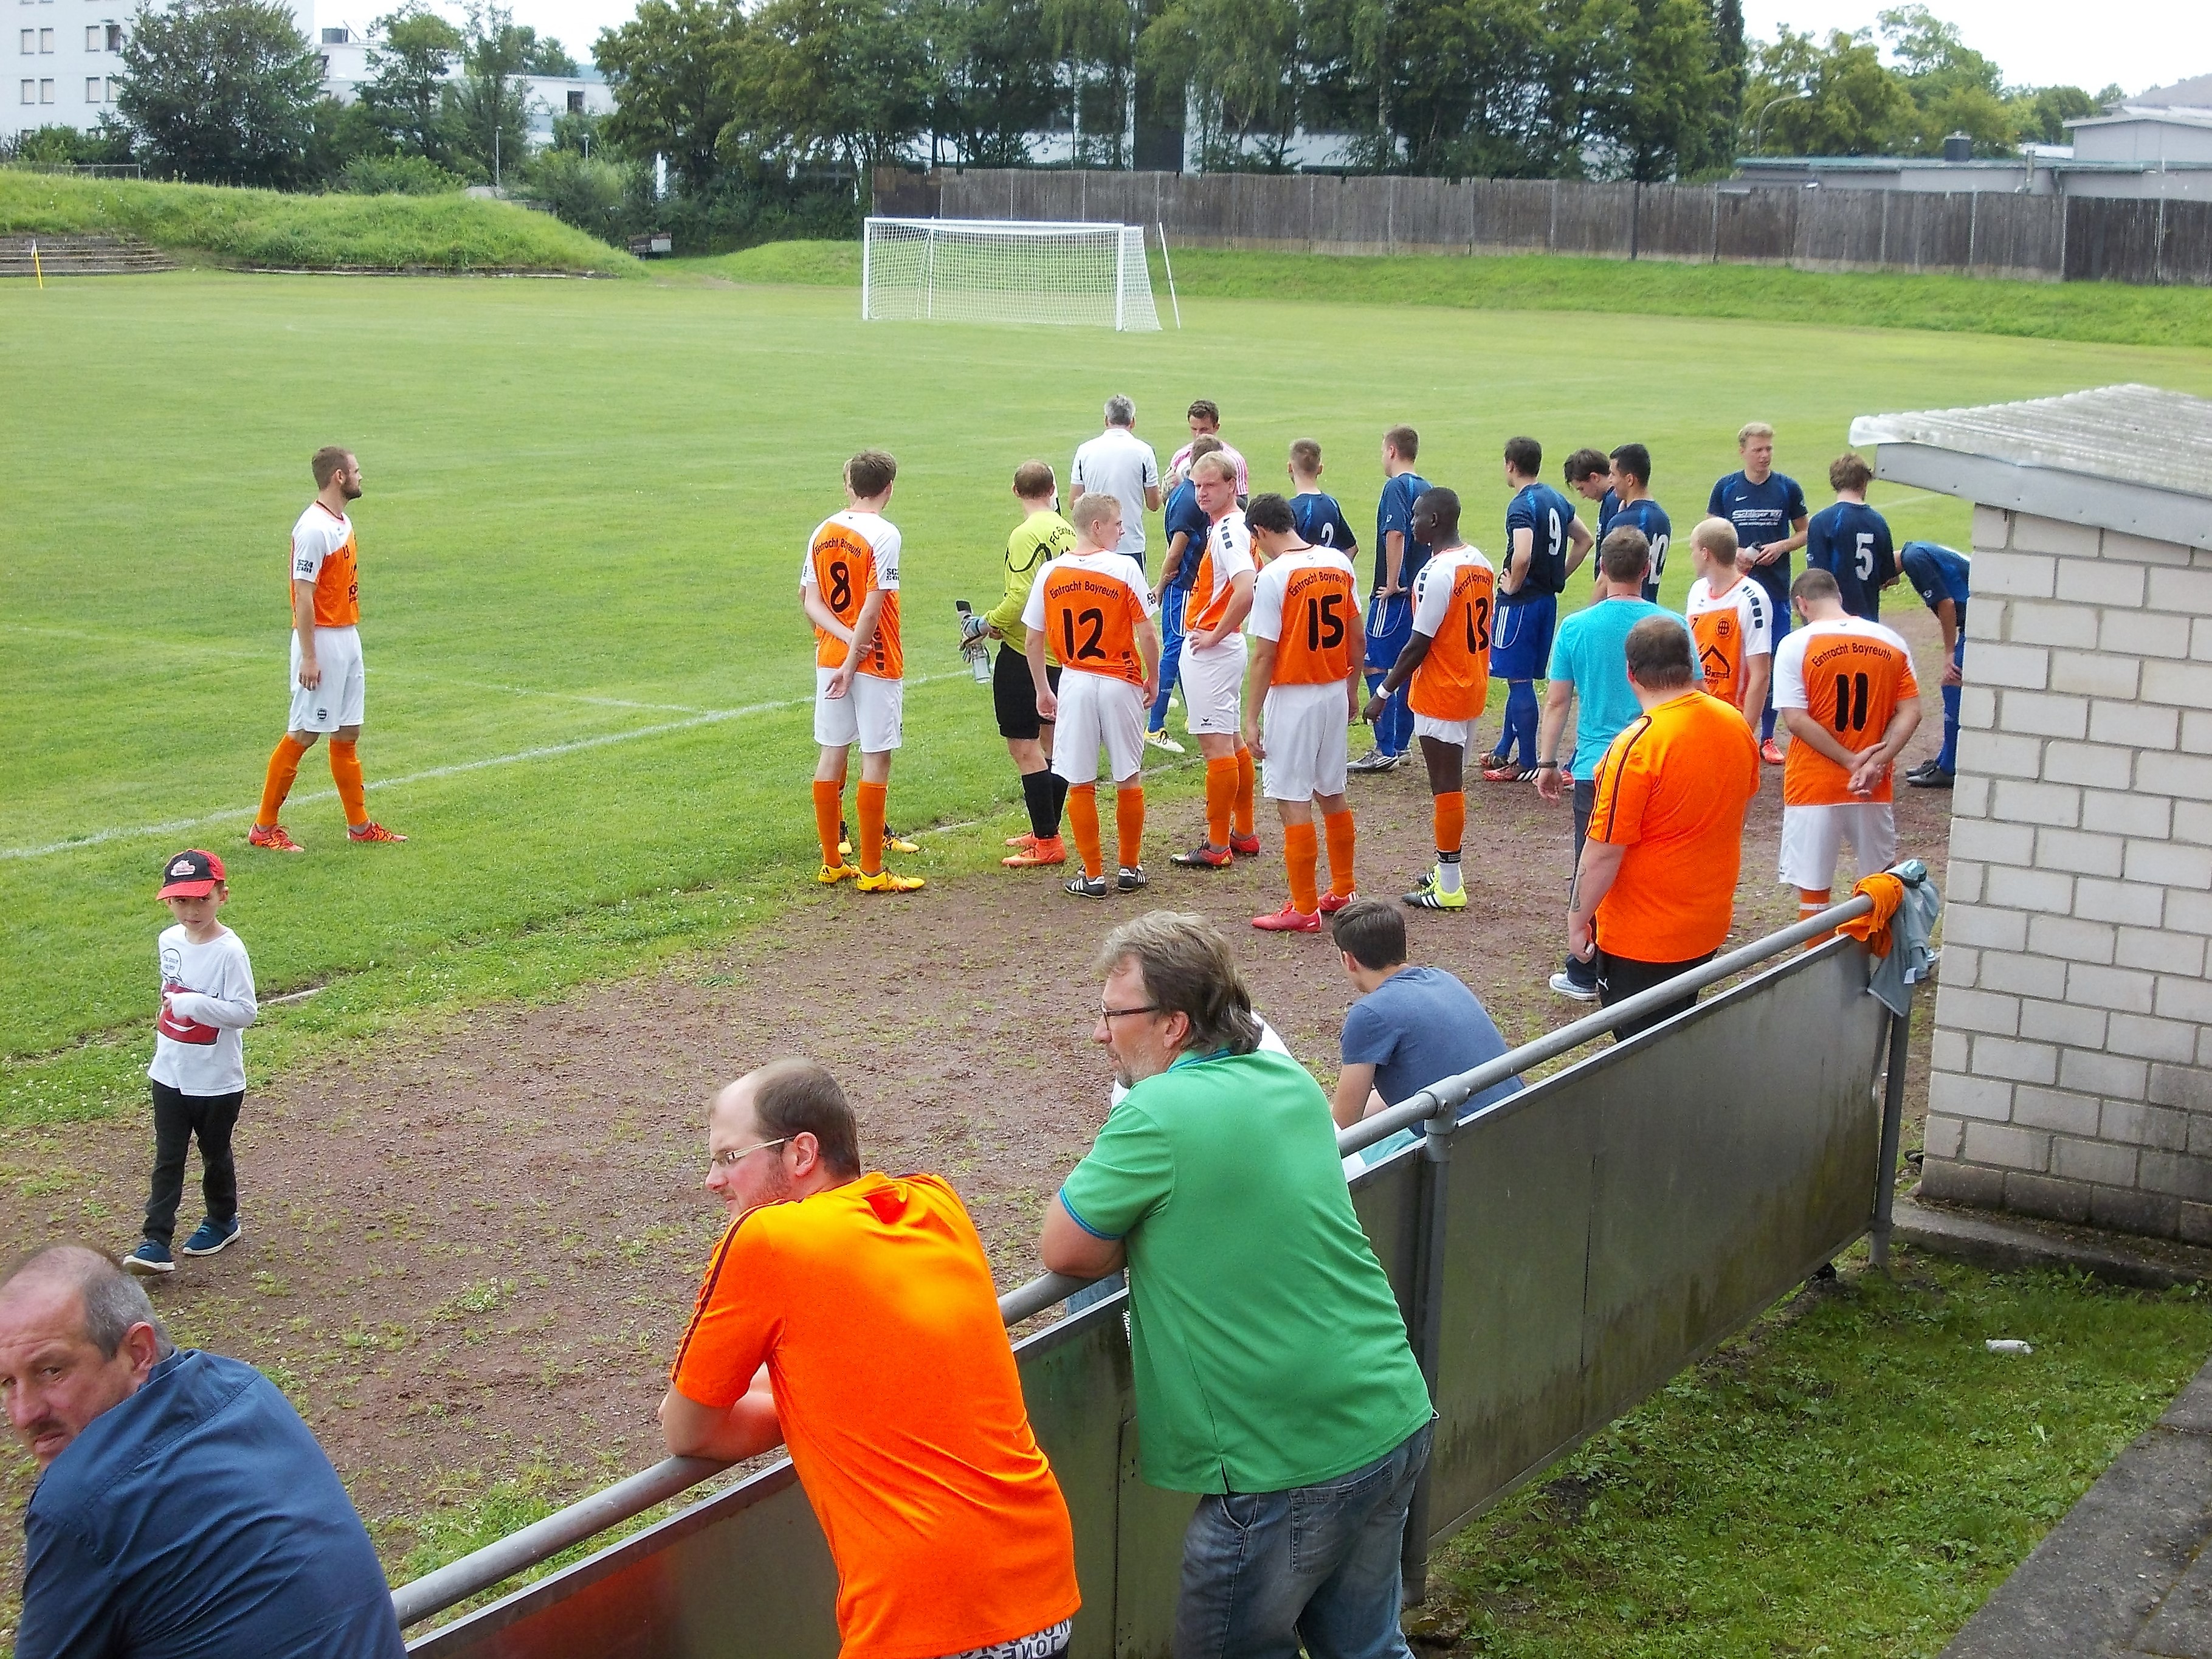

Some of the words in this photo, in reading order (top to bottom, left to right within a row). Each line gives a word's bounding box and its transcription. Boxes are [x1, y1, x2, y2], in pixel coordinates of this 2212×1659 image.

[815, 537, 838, 556] Eintracht
[841, 538, 862, 559] Bayreuth
[1050, 531, 1059, 546] FC
[1321, 522, 1334, 547] 2
[1548, 507, 1562, 556] 9
[1649, 533, 1669, 584] 10
[1855, 533, 1874, 581] 5
[830, 561, 851, 613] 8
[1049, 581, 1081, 599] Eintracht
[1084, 581, 1119, 601] Bayreuth
[1287, 572, 1318, 597] Eintracht
[1063, 608, 1106, 661] 12
[1308, 593, 1344, 652] 15
[1466, 597, 1489, 655] 13
[1811, 644, 1849, 667] Eintracht
[1852, 643, 1892, 661] Bayreuth
[1835, 672, 1869, 732] 11
